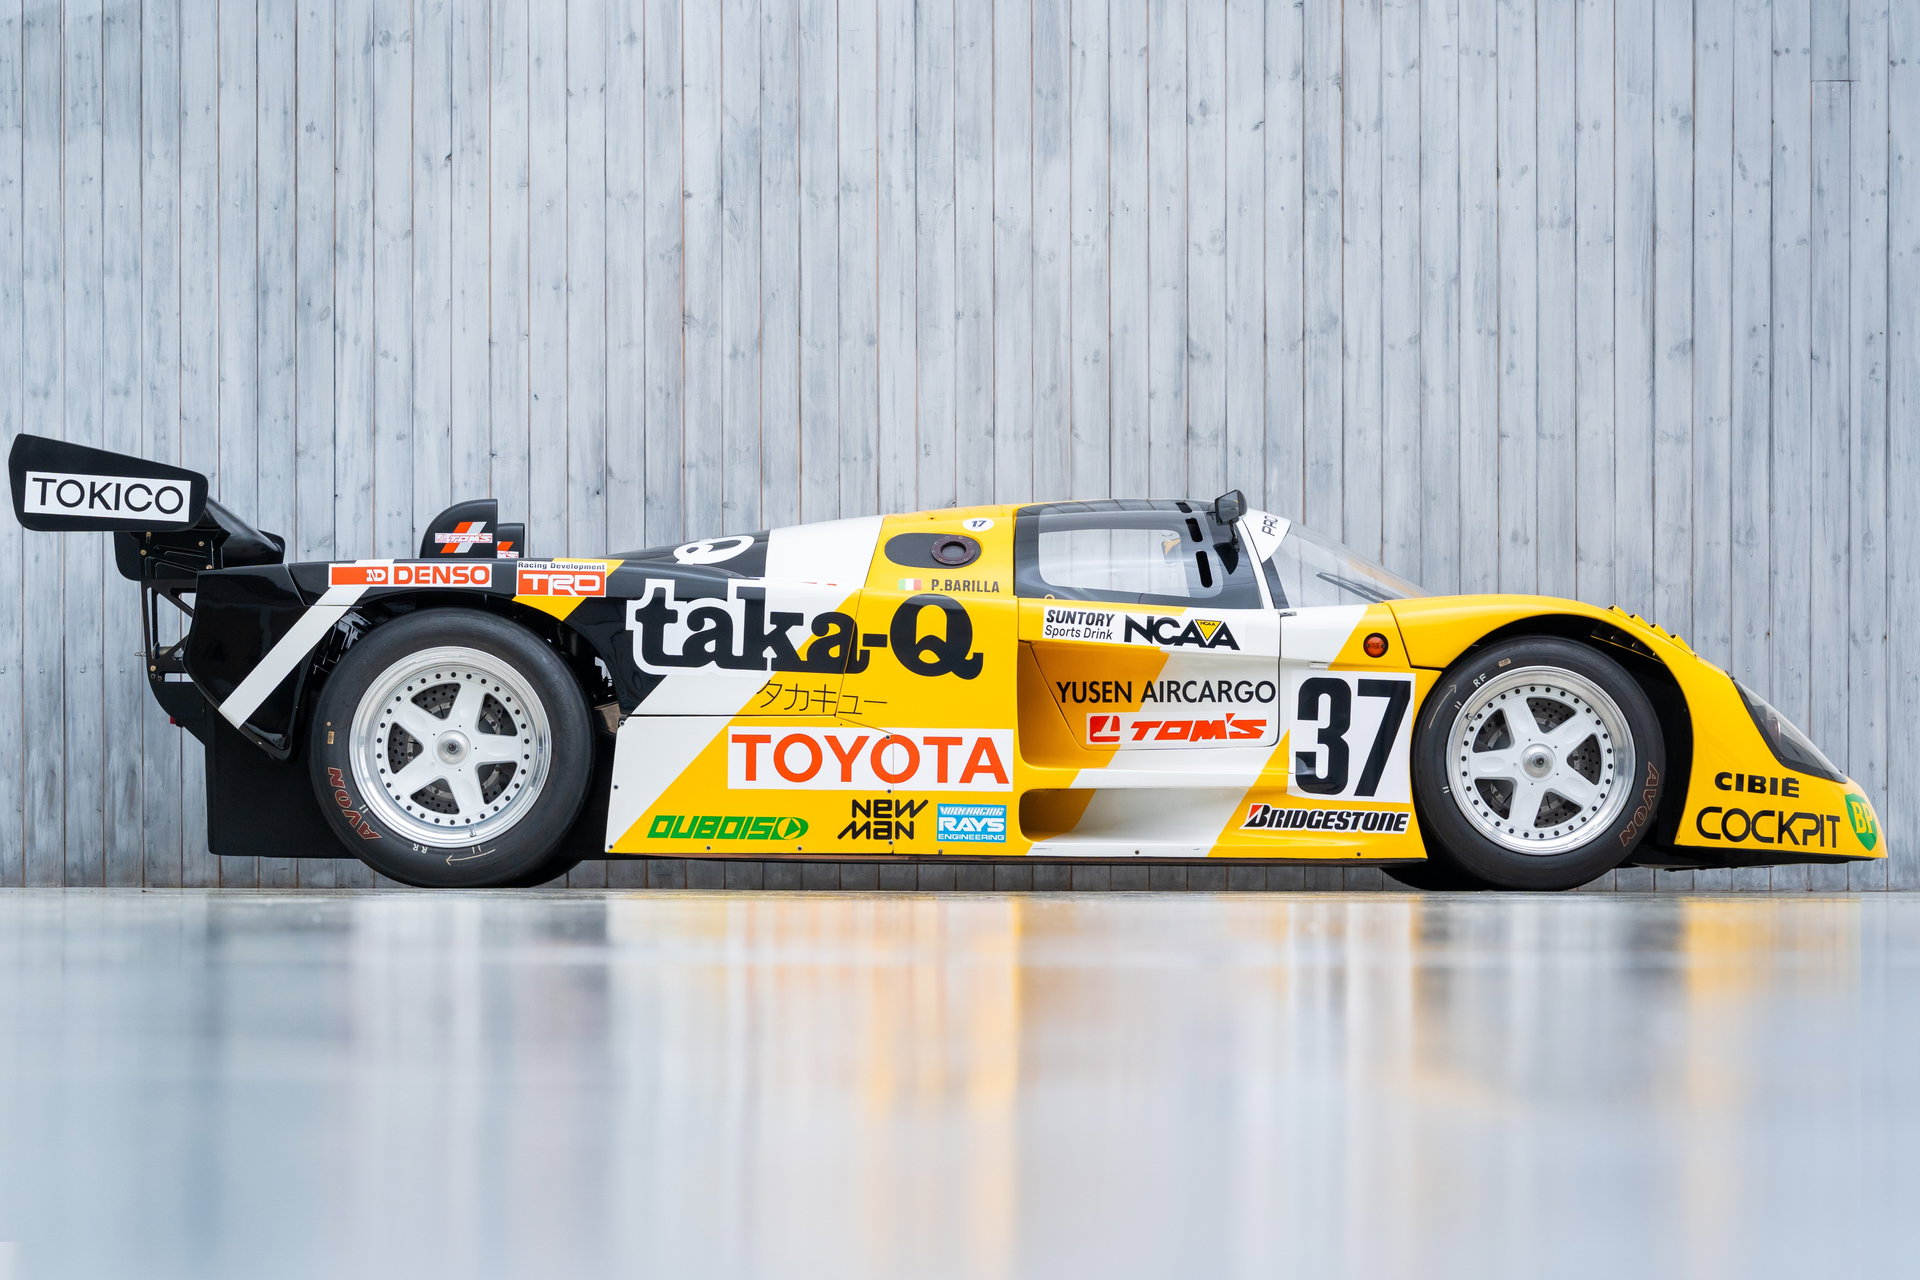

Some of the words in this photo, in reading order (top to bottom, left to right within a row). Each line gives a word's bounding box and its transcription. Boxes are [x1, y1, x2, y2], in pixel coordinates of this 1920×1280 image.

[32, 477, 184, 515] TOKICO
[971, 520, 987, 528] 17
[393, 566, 490, 585] DENSO
[518, 561, 547, 570] Racing
[550, 563, 605, 571] Development
[522, 573, 601, 597] TRD
[931, 579, 1000, 593] P.BARILLA
[632, 584, 984, 680] taka-Q
[1046, 609, 1115, 627] SUNTORY
[1124, 614, 1240, 650] NCAA
[1045, 625, 1081, 639] Sports
[1084, 628, 1113, 640] Drink
[756, 679, 888, 715] タカキュー
[1056, 681, 1132, 703] YUSEN
[1140, 680, 1276, 703] AIRCARGO
[1131, 713, 1267, 741] TOM'S
[1295, 677, 1411, 797] 37
[731, 733, 1010, 784] TOYOTA
[328, 767, 382, 840] AVON
[1618, 762, 1660, 848] AVON
[1850, 801, 1874, 834] BP
[938, 817, 1005, 832] RAYS
[1244, 804, 1408, 832] BRIDGESTONE
[1696, 806, 1840, 848] COCKPIT
[938, 833, 1005, 841] ENGINEERING
